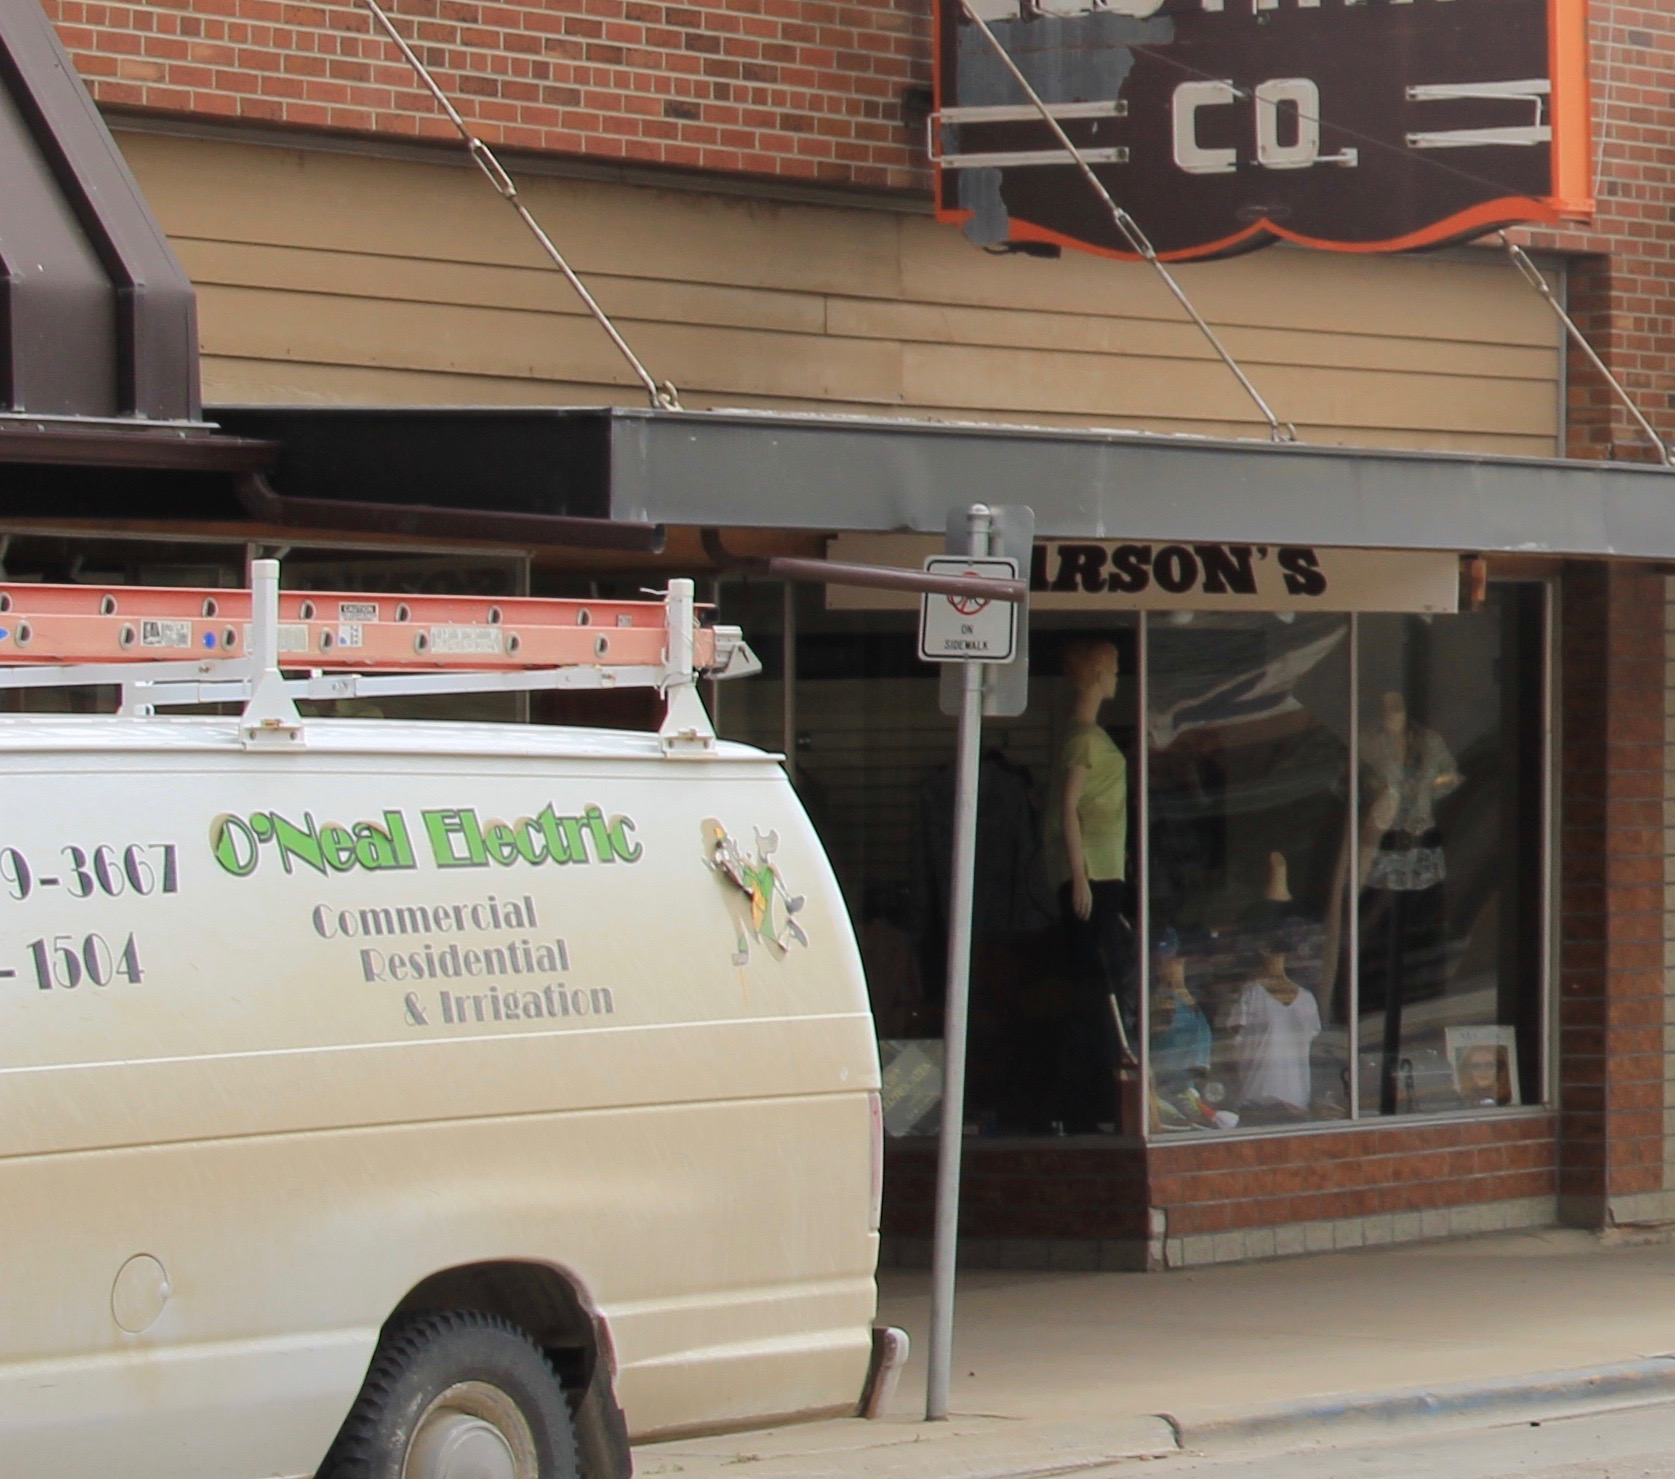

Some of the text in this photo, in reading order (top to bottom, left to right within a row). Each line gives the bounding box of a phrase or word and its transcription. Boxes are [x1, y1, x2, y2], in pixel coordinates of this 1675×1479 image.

[1172, 77, 1358, 173] CO.
[944, 639, 989, 652] SIDEWALK
[961, 624, 973, 636] ON
[208, 801, 644, 878] O'Neal Electric
[312, 895, 539, 939] Commercial
[359, 938, 571, 983] Residential
[403, 983, 616, 1027] & Irrigation
